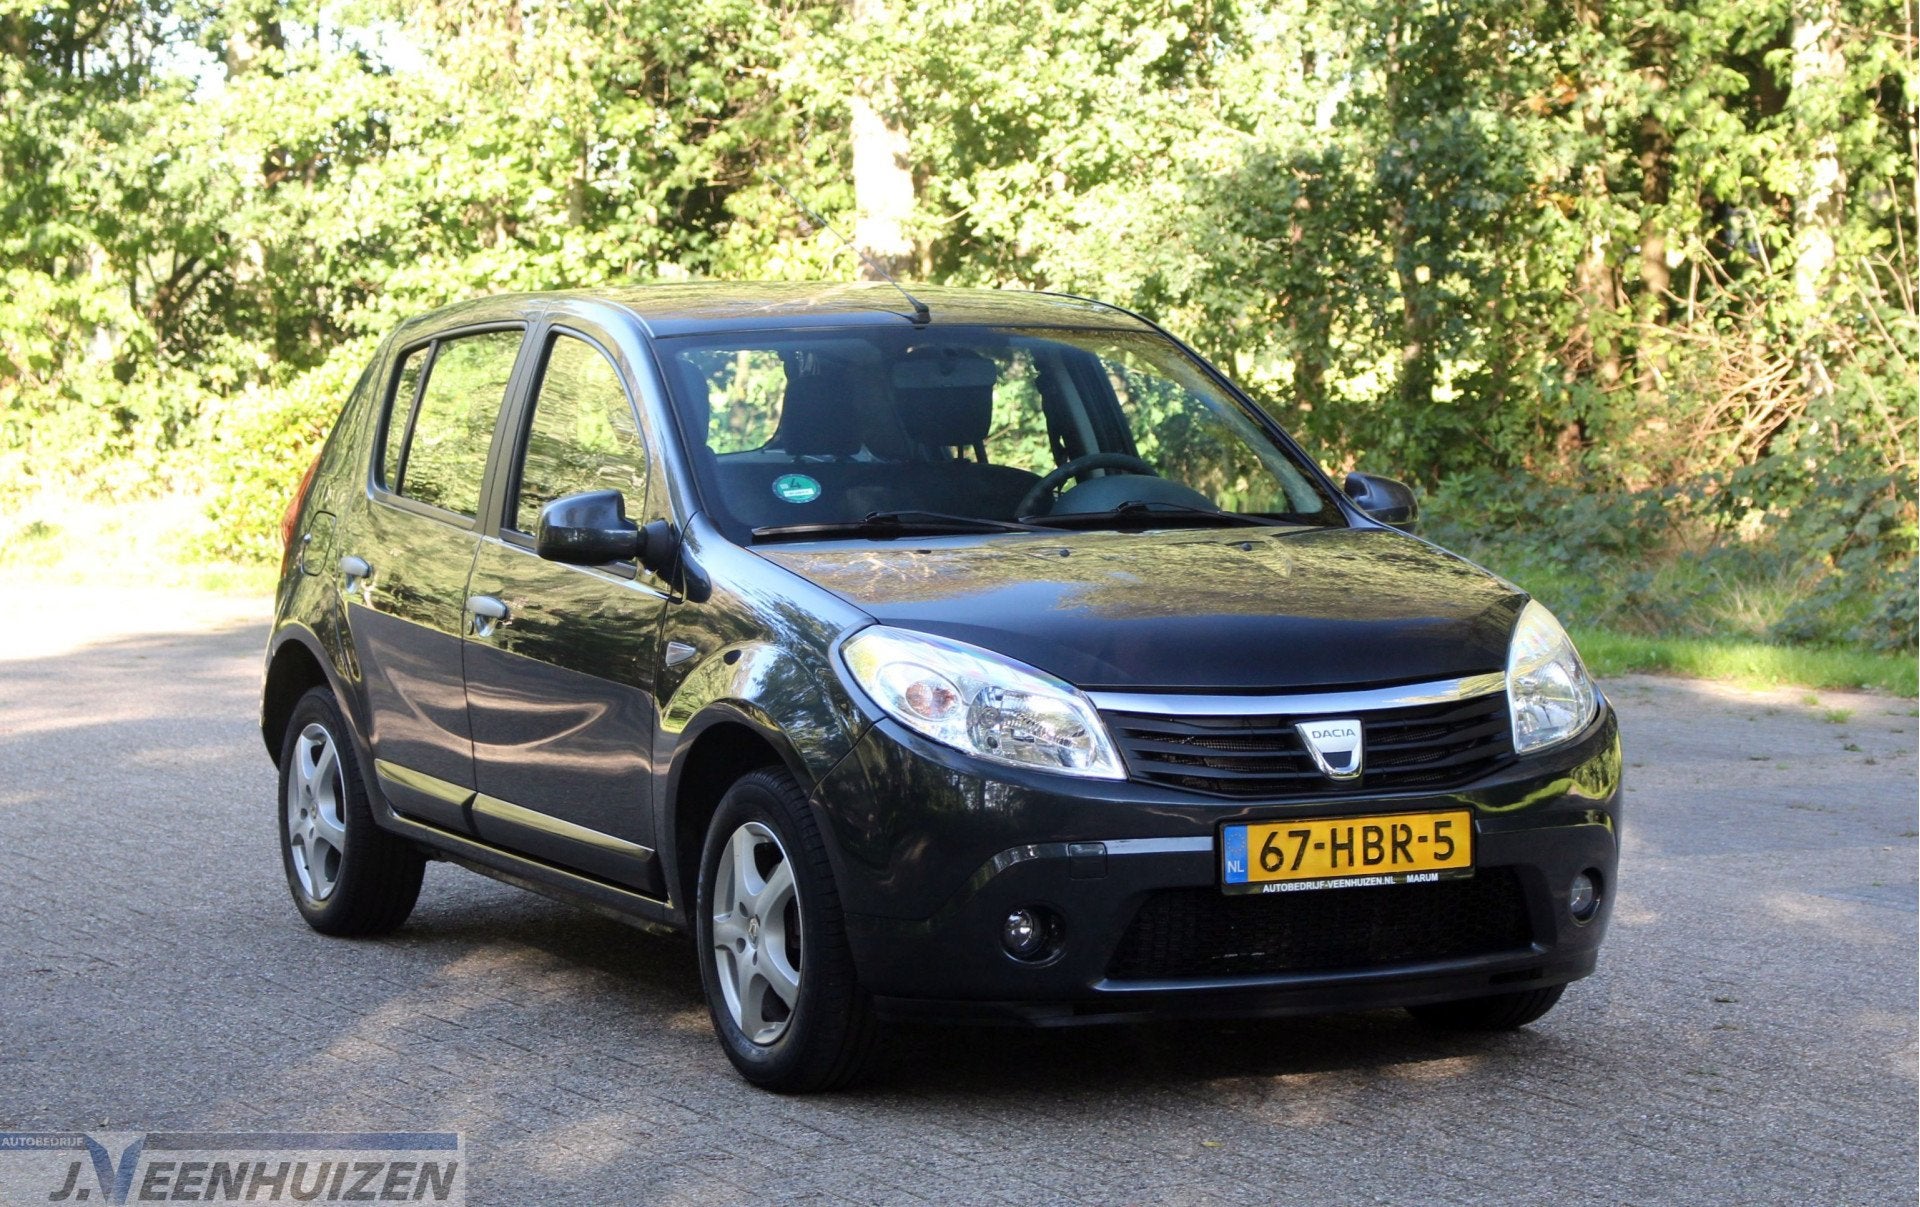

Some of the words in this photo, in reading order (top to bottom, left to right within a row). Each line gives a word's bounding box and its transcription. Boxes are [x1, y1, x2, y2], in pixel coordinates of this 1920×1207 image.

[1312, 728, 1356, 739] DACIA
[1260, 821, 1455, 872] 67-HBR-5
[1227, 861, 1244, 873] NL
[1263, 877, 1396, 893] AUTOBEDRIJF-VEENHUIZEN.NL
[1406, 873, 1439, 883] MARUM
